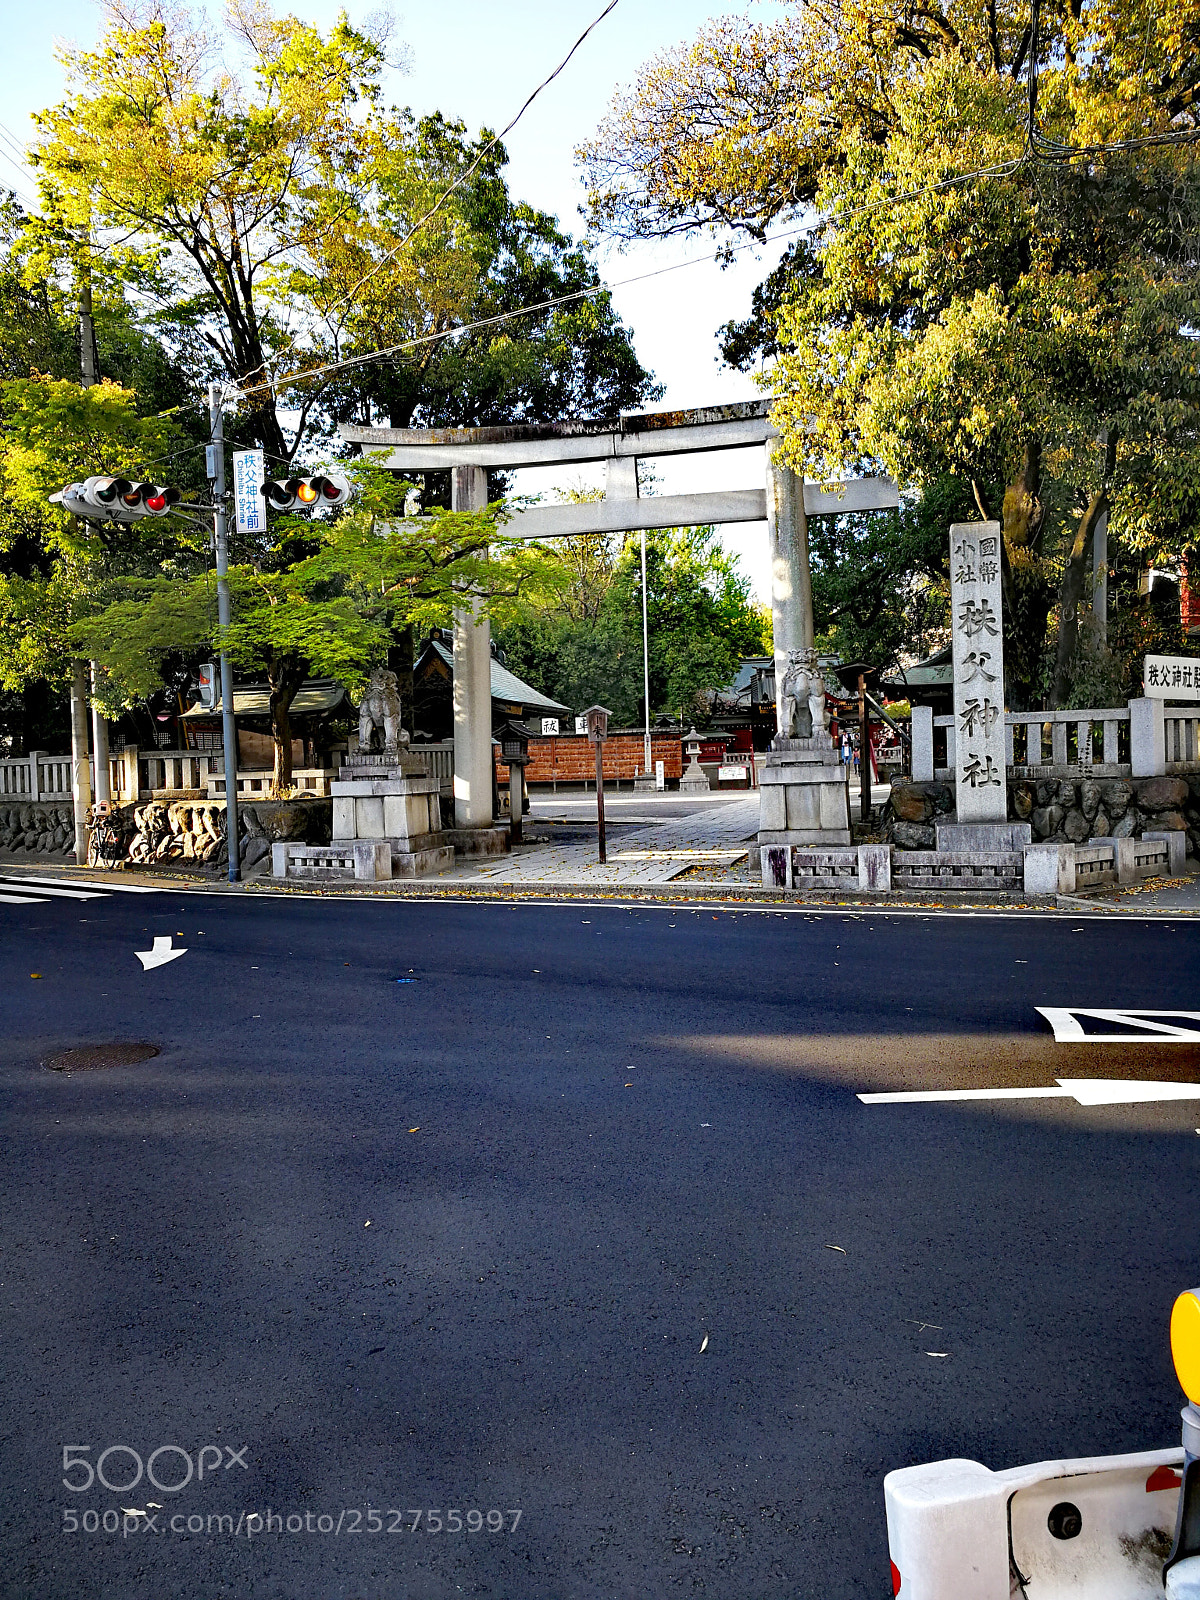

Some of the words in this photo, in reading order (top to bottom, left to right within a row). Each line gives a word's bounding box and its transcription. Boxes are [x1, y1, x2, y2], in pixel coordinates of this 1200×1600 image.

[237, 460, 245, 495] Chichibu
[244, 454, 259, 529] 秩父神社前
[238, 498, 246, 524] Shrine
[954, 539, 977, 585] 小社
[957, 598, 1002, 788] 秩父神社
